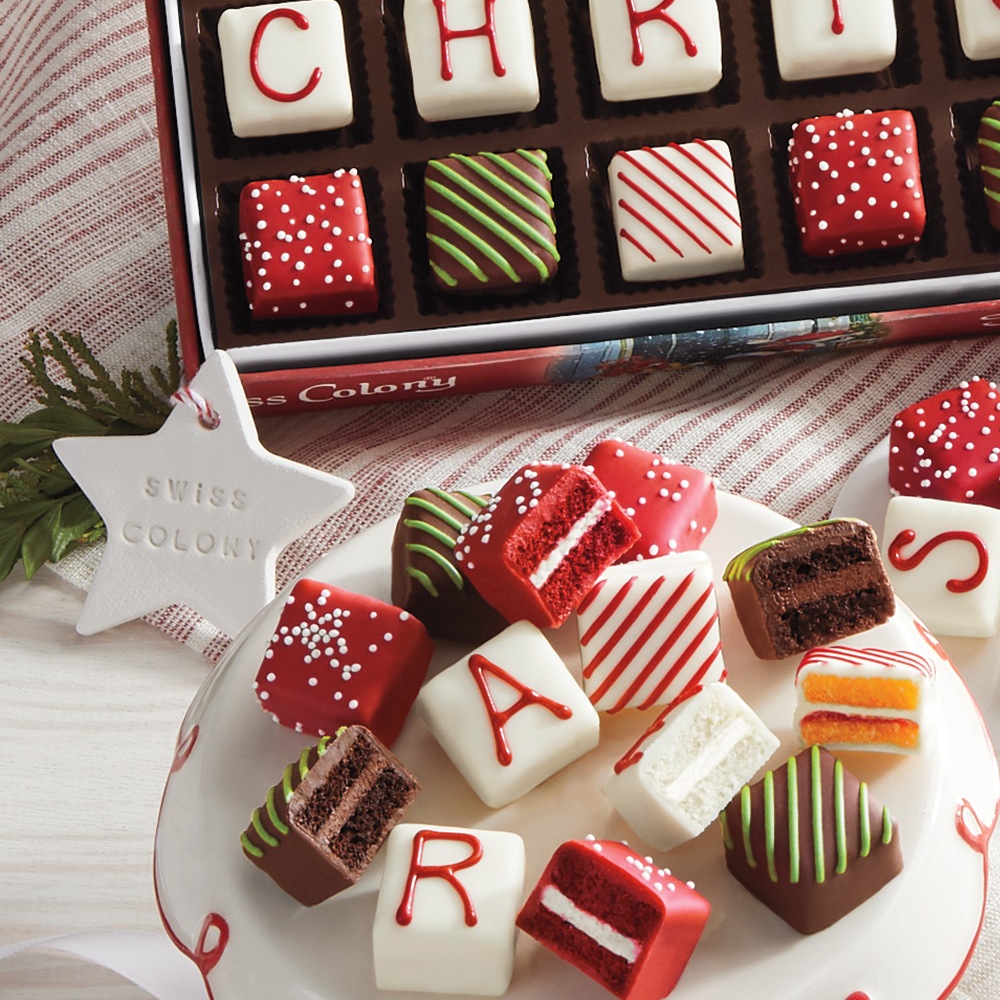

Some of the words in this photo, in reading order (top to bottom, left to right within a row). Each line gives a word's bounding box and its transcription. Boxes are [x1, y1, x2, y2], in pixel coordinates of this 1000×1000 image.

[298, 376, 457, 403] Colony
[122, 521, 260, 561] COLONY
[888, 529, 989, 593] S
[469, 653, 573, 767] A
[395, 829, 484, 927] R
